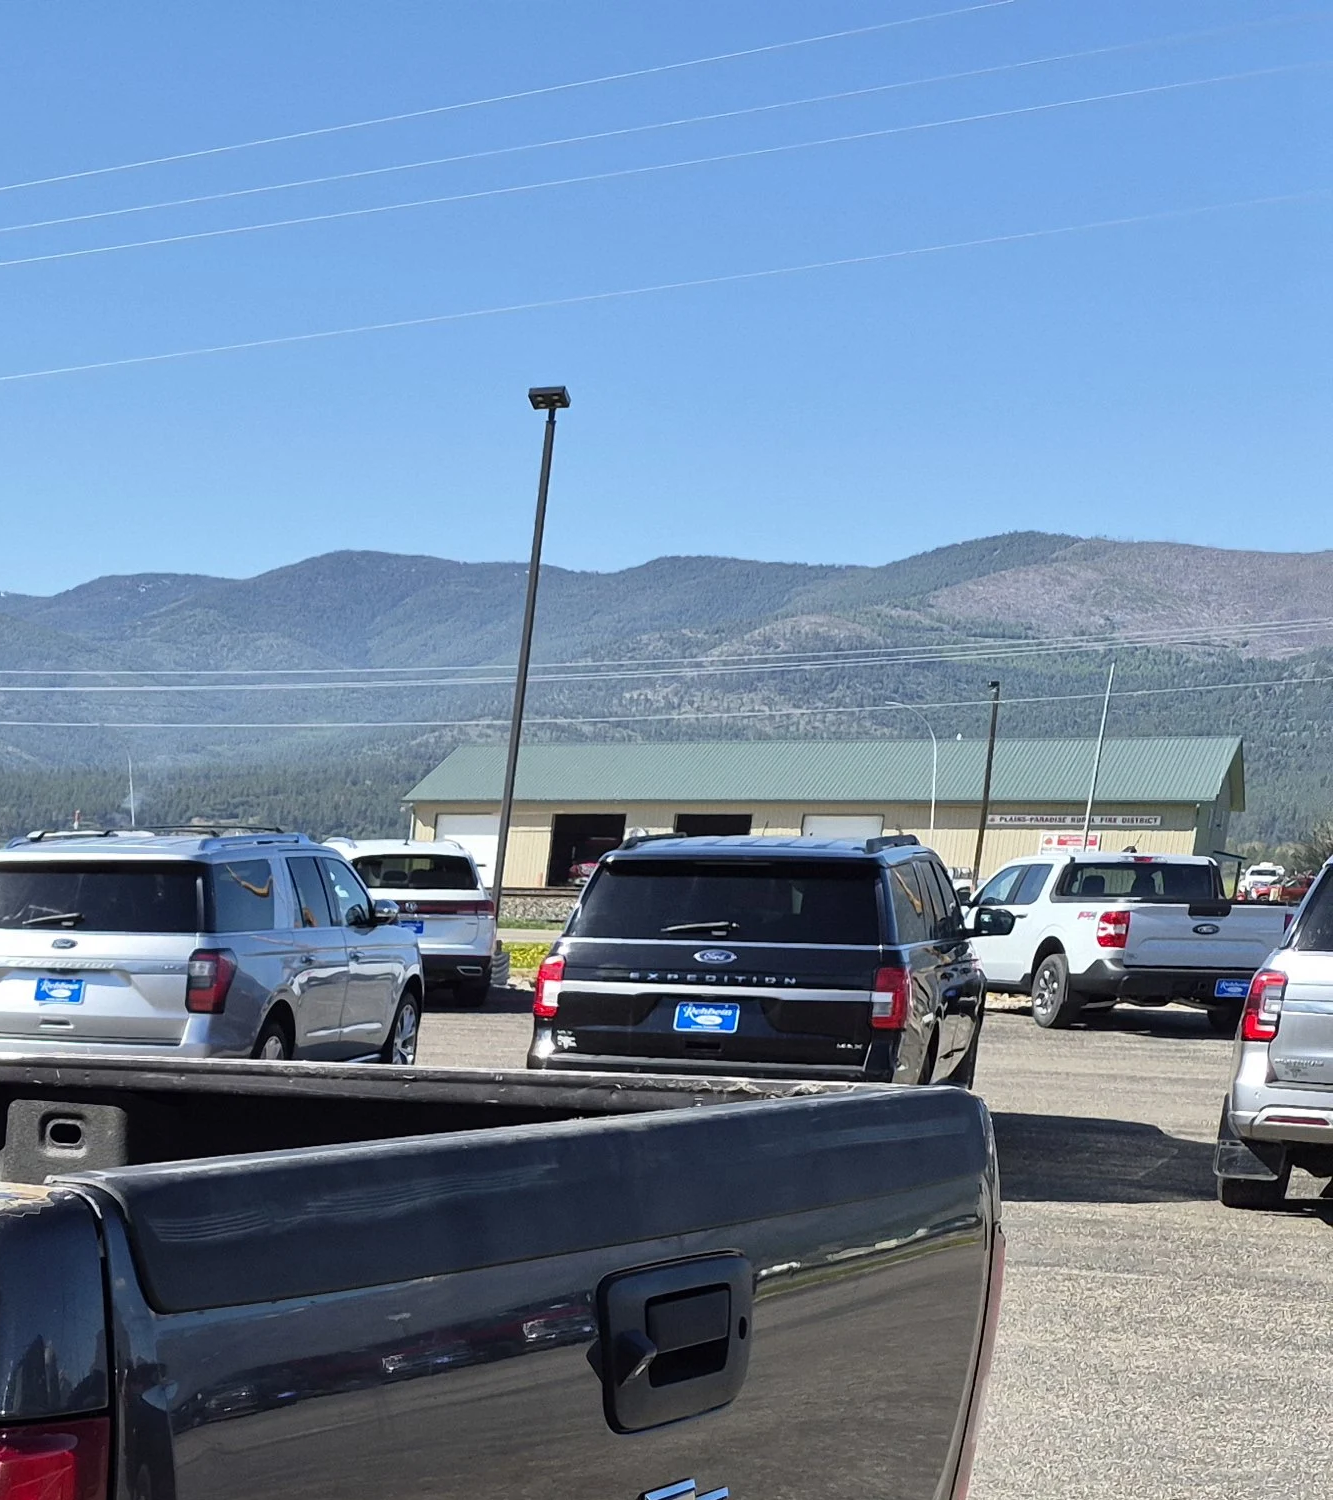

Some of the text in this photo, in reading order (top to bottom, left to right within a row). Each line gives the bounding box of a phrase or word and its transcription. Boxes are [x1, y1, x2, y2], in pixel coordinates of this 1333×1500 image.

[1070, 815, 1096, 824] RURL
[1121, 816, 1158, 825] DISTRICT
[630, 972, 796, 984] EXPEDITION
